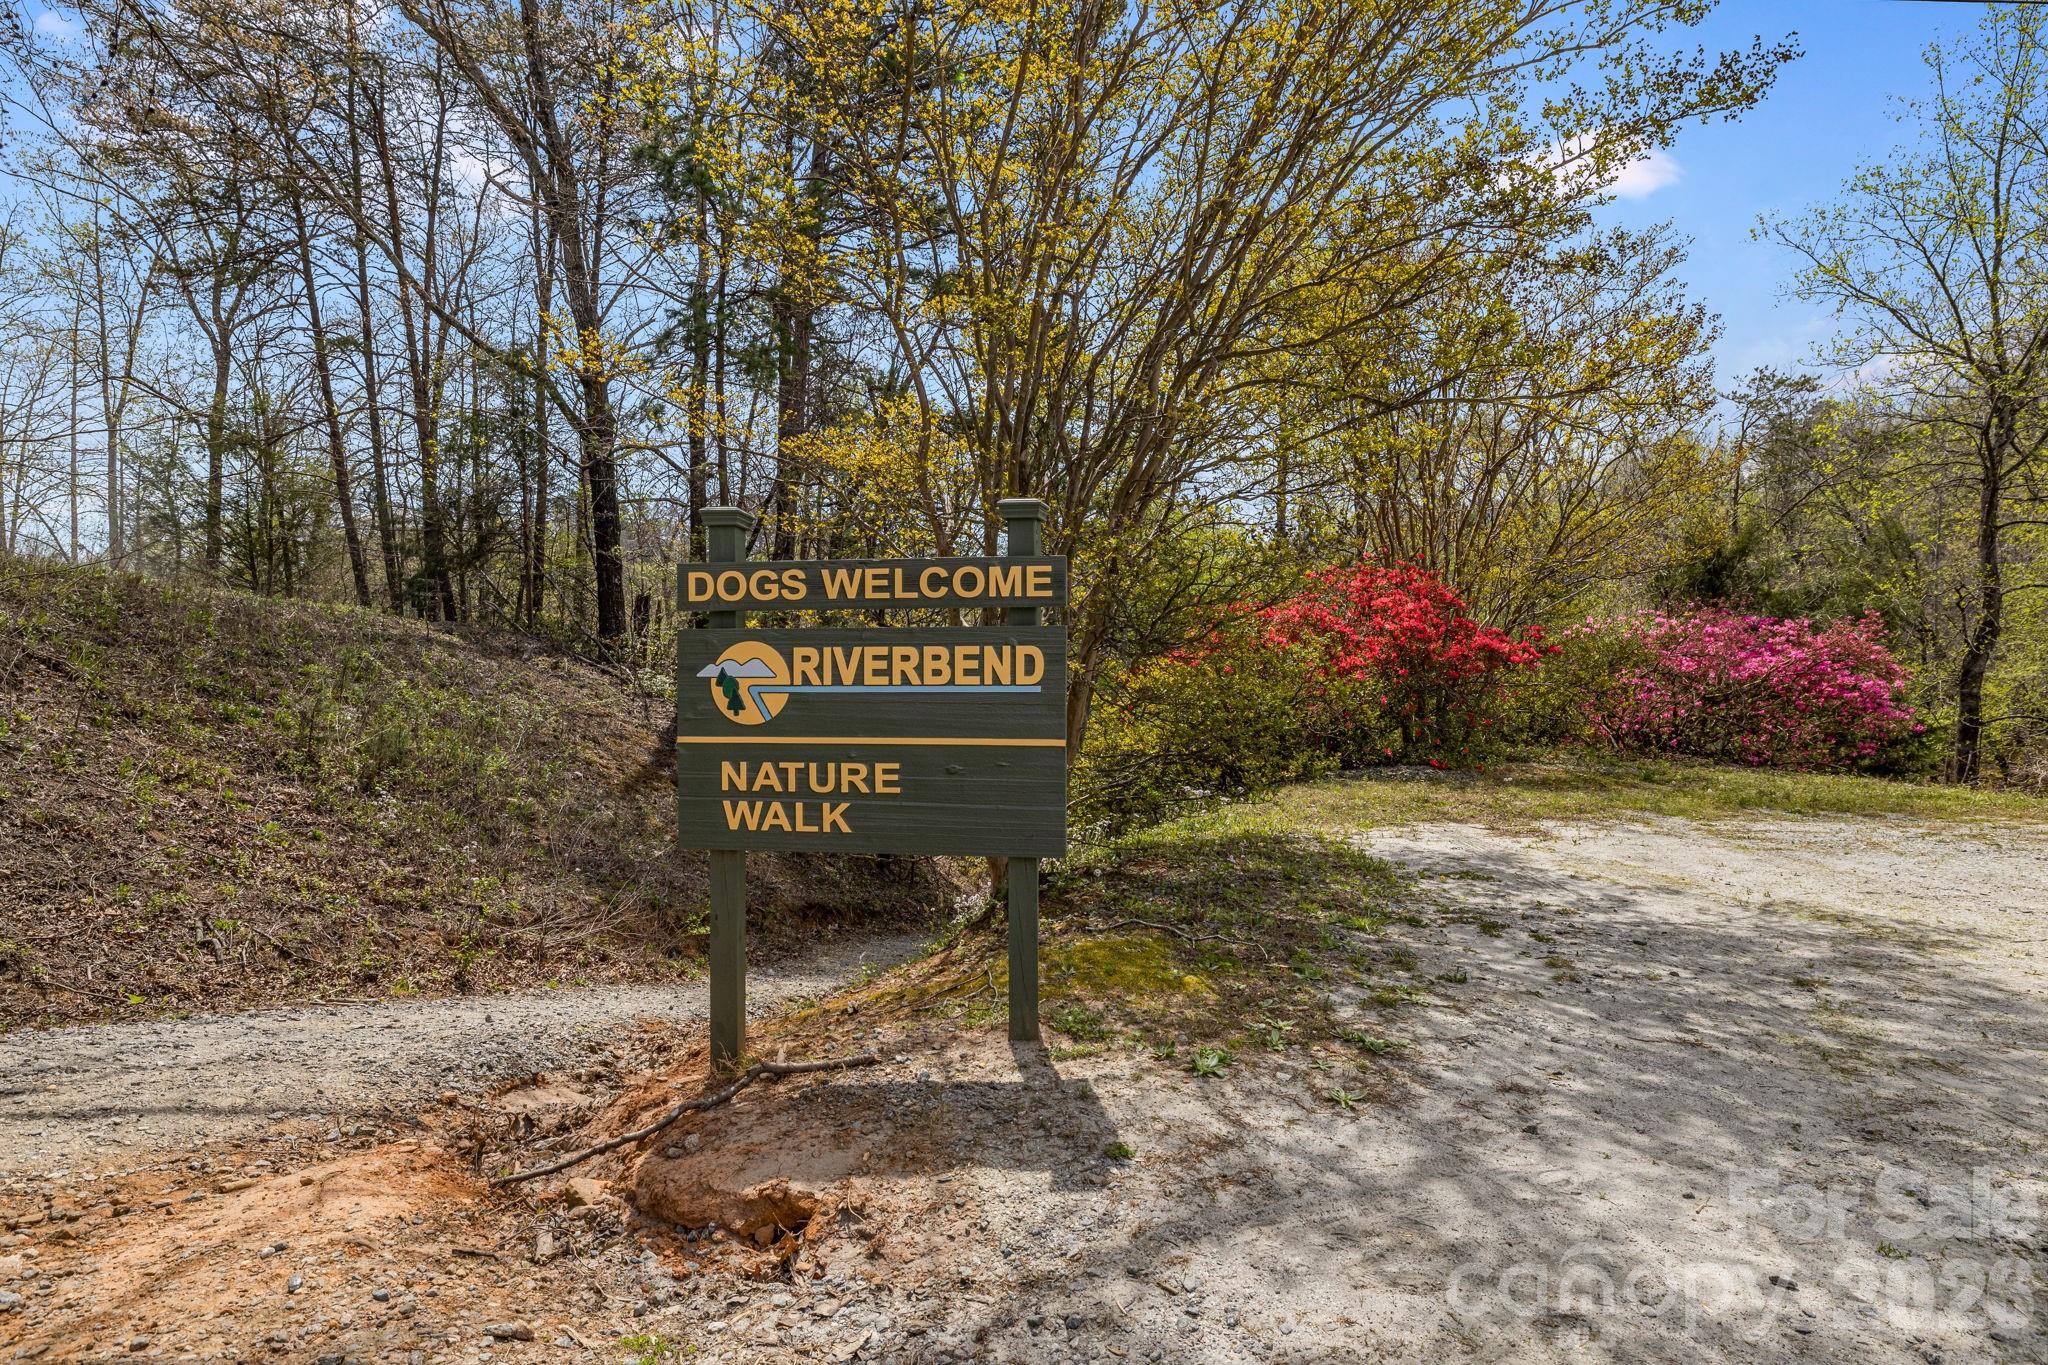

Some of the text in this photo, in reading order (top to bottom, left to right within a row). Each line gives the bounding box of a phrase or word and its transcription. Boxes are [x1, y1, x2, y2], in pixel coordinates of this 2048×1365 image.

[687, 565, 1053, 603] DOGS WELCOME
[793, 645, 1045, 687] RIVERBEND
[721, 761, 902, 795] NATURE
[722, 800, 852, 834] WALK
